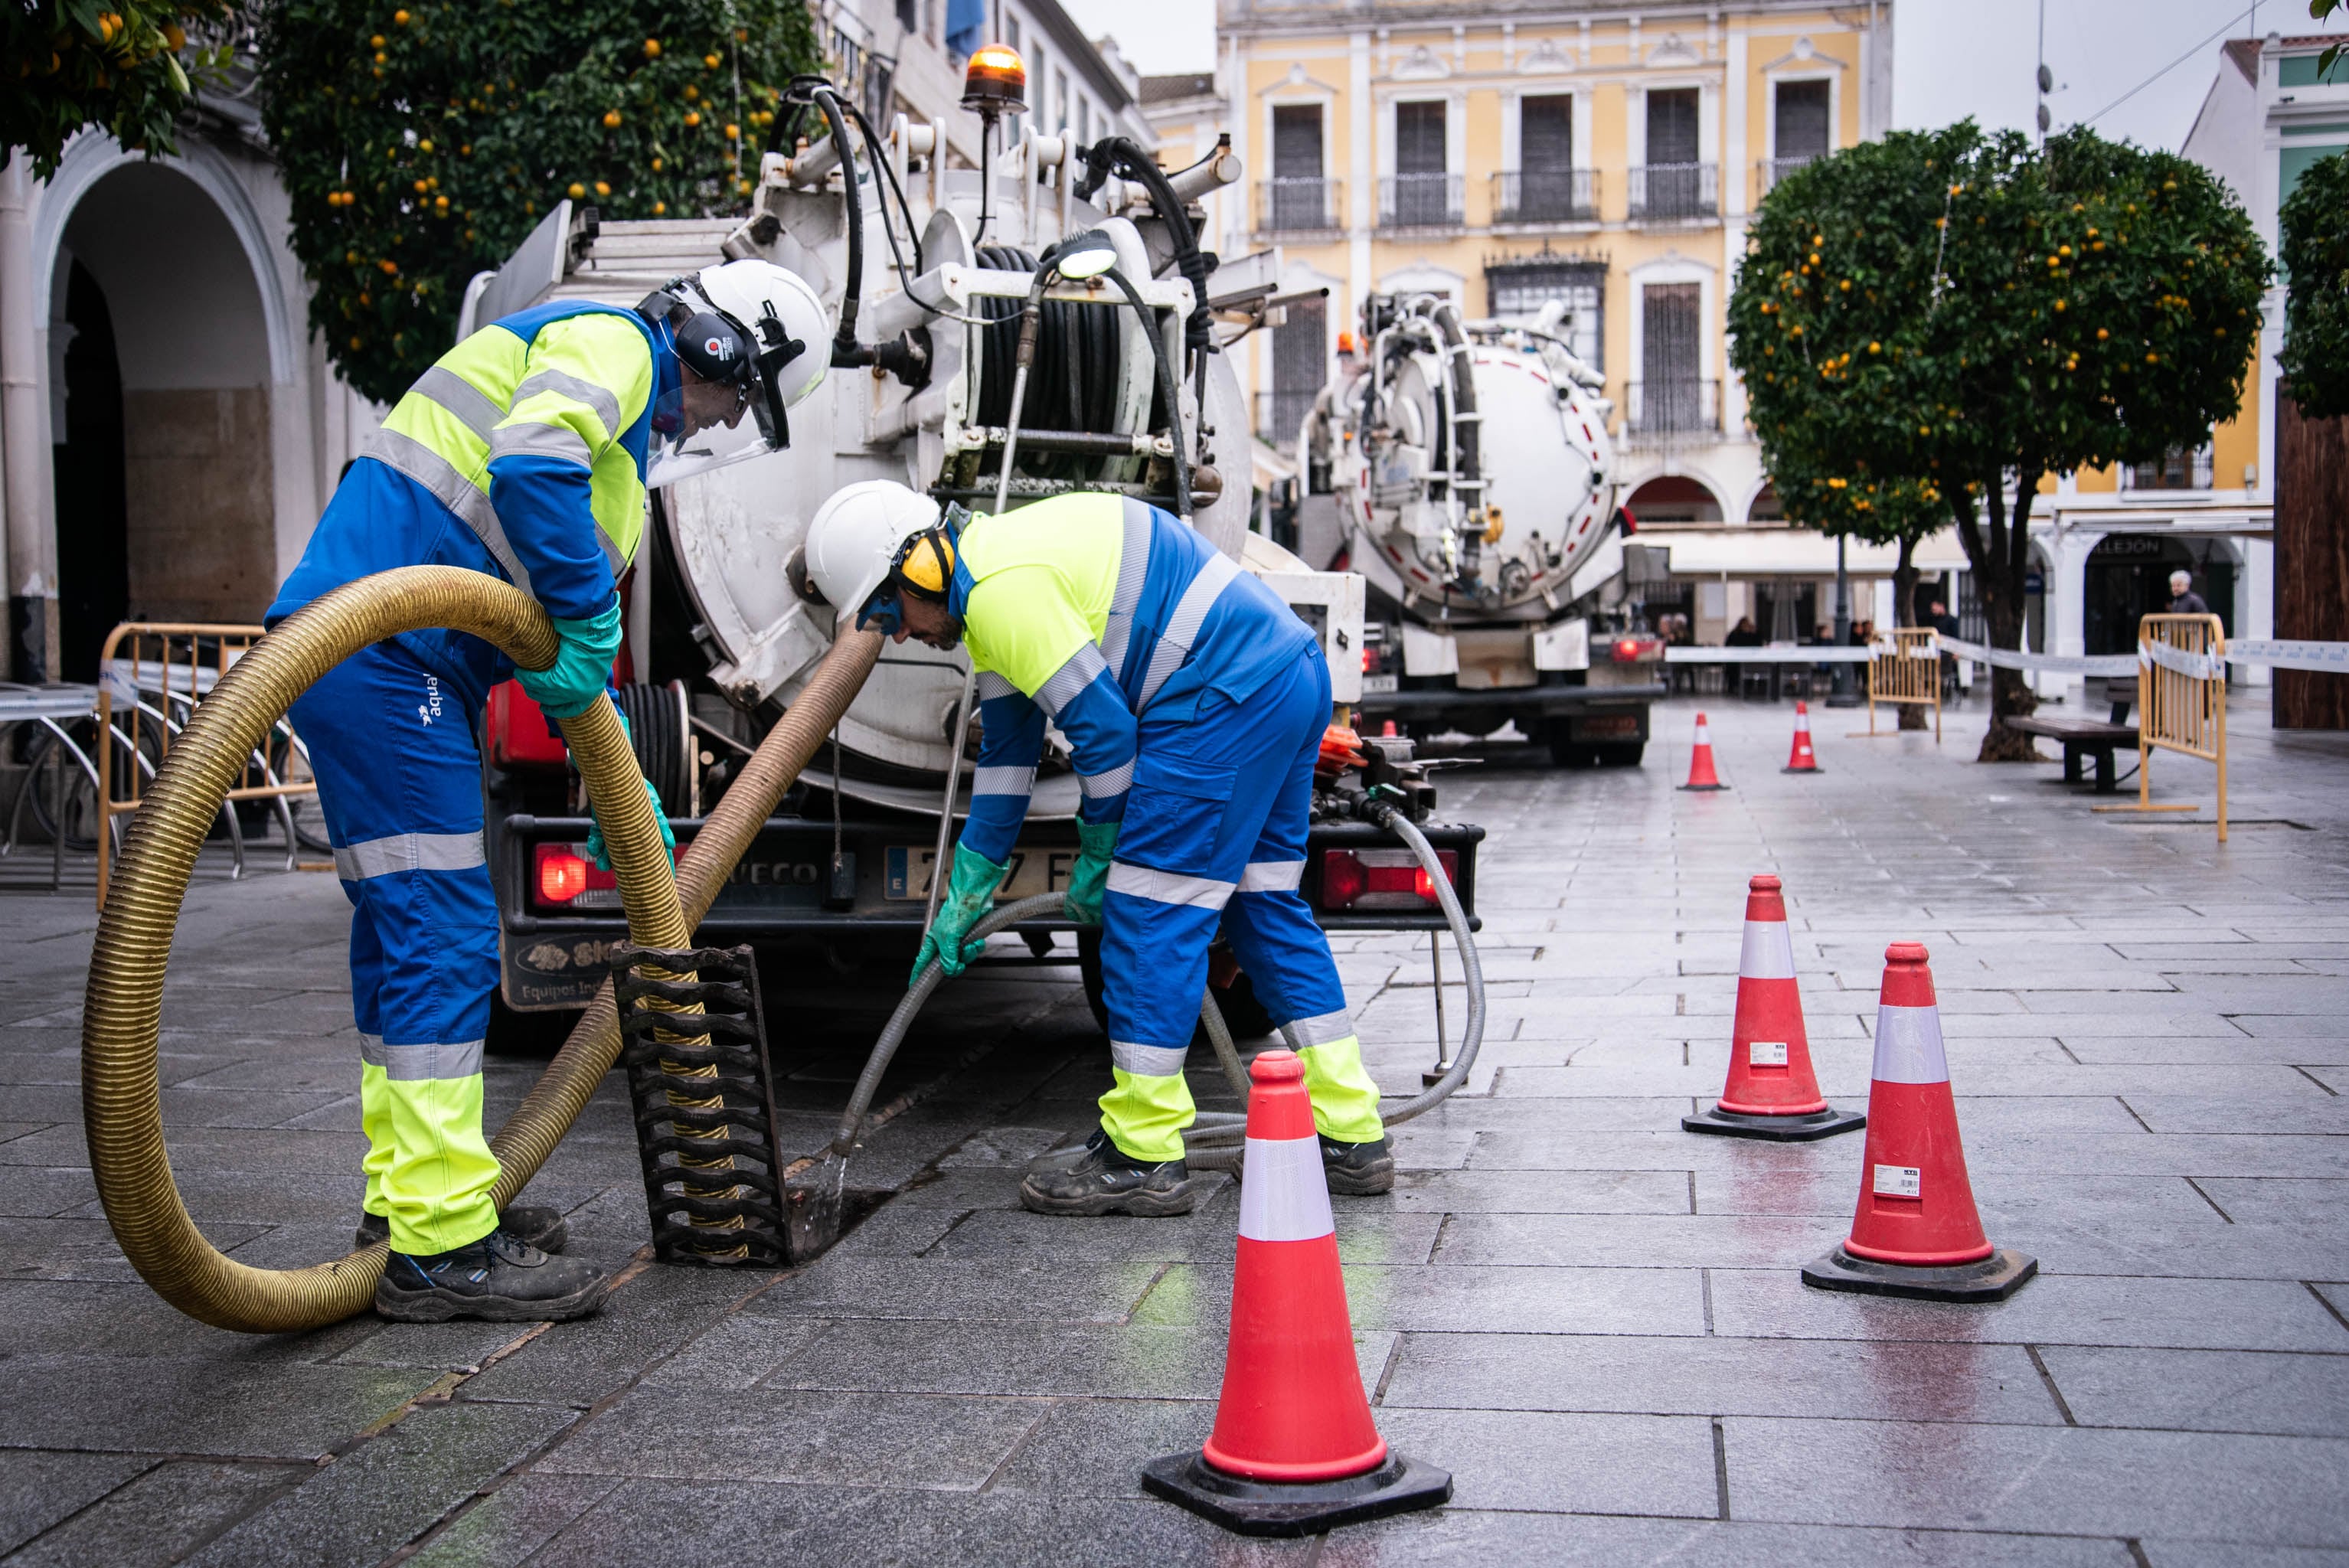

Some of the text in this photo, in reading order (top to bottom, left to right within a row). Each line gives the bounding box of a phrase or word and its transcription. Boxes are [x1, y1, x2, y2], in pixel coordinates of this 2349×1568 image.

[730, 863, 818, 884] VECO
[892, 878, 902, 890] E
[521, 985, 576, 1001] Equipos
